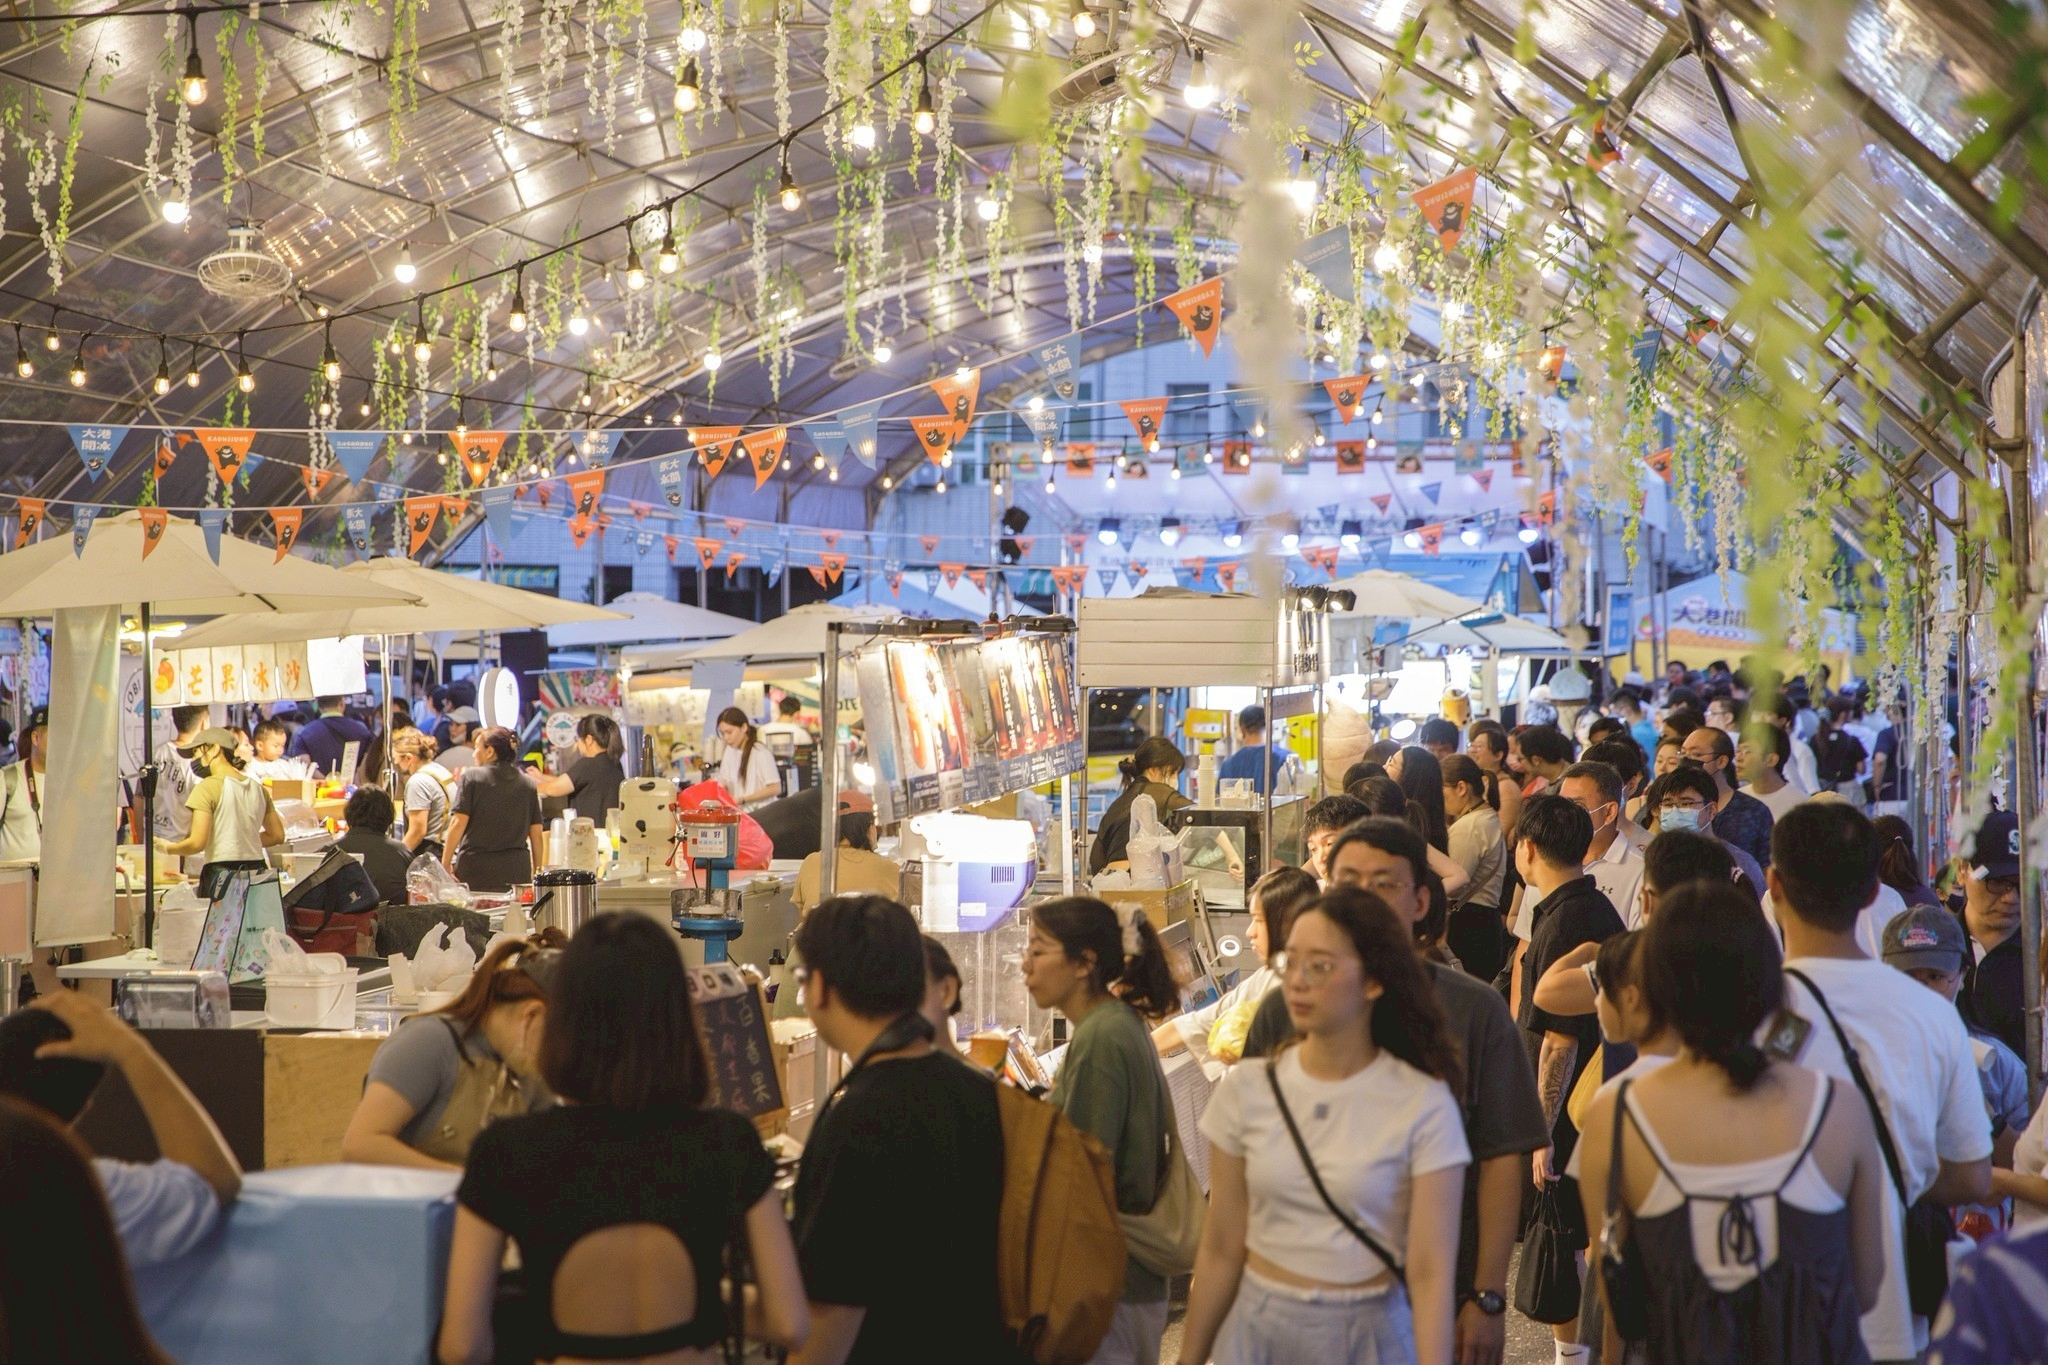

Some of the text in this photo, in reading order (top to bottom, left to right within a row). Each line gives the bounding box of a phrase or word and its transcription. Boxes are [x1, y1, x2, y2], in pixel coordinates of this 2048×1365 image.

[82, 428, 112, 439] 大港
[81, 440, 111, 451] 開冰
[1673, 606, 1747, 627] 大港開
[187, 659, 301, 696] 芒果冰沙
